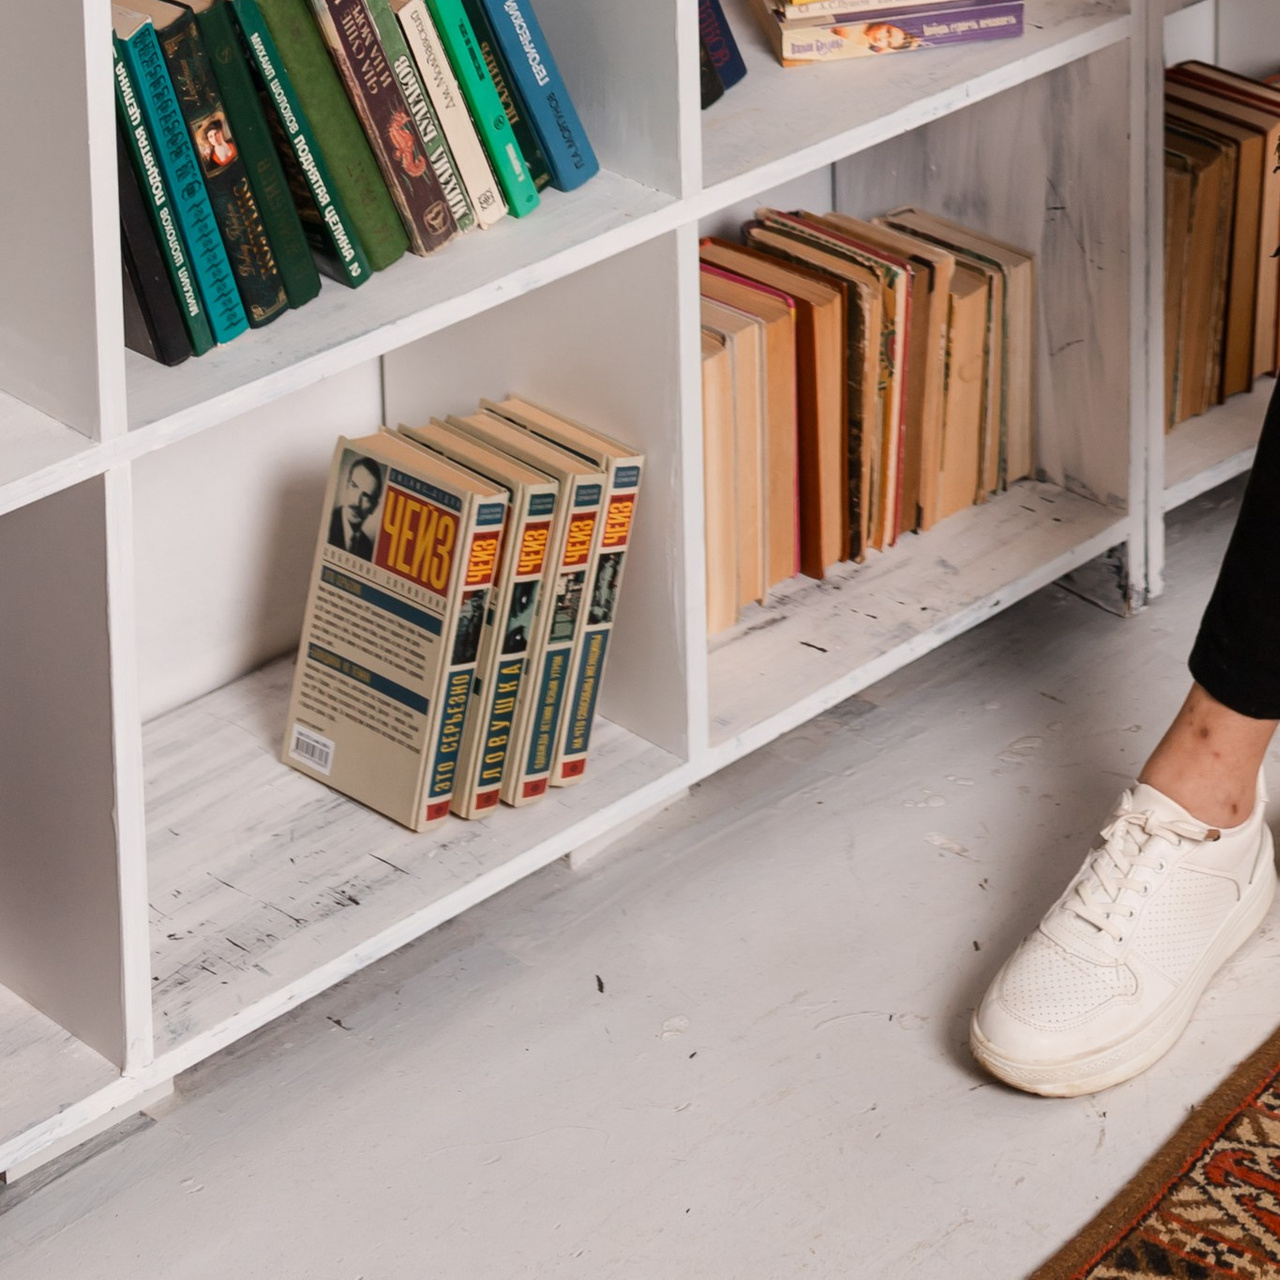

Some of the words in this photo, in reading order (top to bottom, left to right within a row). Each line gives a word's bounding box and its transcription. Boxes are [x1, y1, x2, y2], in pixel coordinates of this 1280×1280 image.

[340, 7, 369, 61] СУШЕ
[353, 0, 381, 53] МОРЕ
[114, 60, 141, 126] ЦЕЛИНА
[393, 54, 438, 145] БУЛГАКОВ
[135, 124, 166, 206] ПОДНЯТАЯ
[250, 31, 277, 80] МИХАИЛ
[270, 75, 301, 135] ШОЛОХОВ
[294, 134, 329, 208] ПОДНЯТАЯ
[325, 204, 357, 263] ЦЕЛИНА
[350, 263, 363, 278] 2
[430, 141, 470, 222] МИХАИЛ
[159, 207, 184, 267] ШОЛОХОВ
[179, 268, 200, 317] МИХАИЛ
[382, 490, 457, 592] ЧЕЙЗ
[518, 527, 550, 574] ЧЕЙЗ
[564, 518, 595, 566] ЧЕЙЗ
[603, 498, 634, 547] ЧЕЙЗ
[466, 537, 498, 584] ЧЕЙЗ
[440, 673, 471, 754] СЕРЬЕЗНО
[482, 662, 523, 781] ЛОВУШКА
[434, 756, 455, 794] ЭТО
